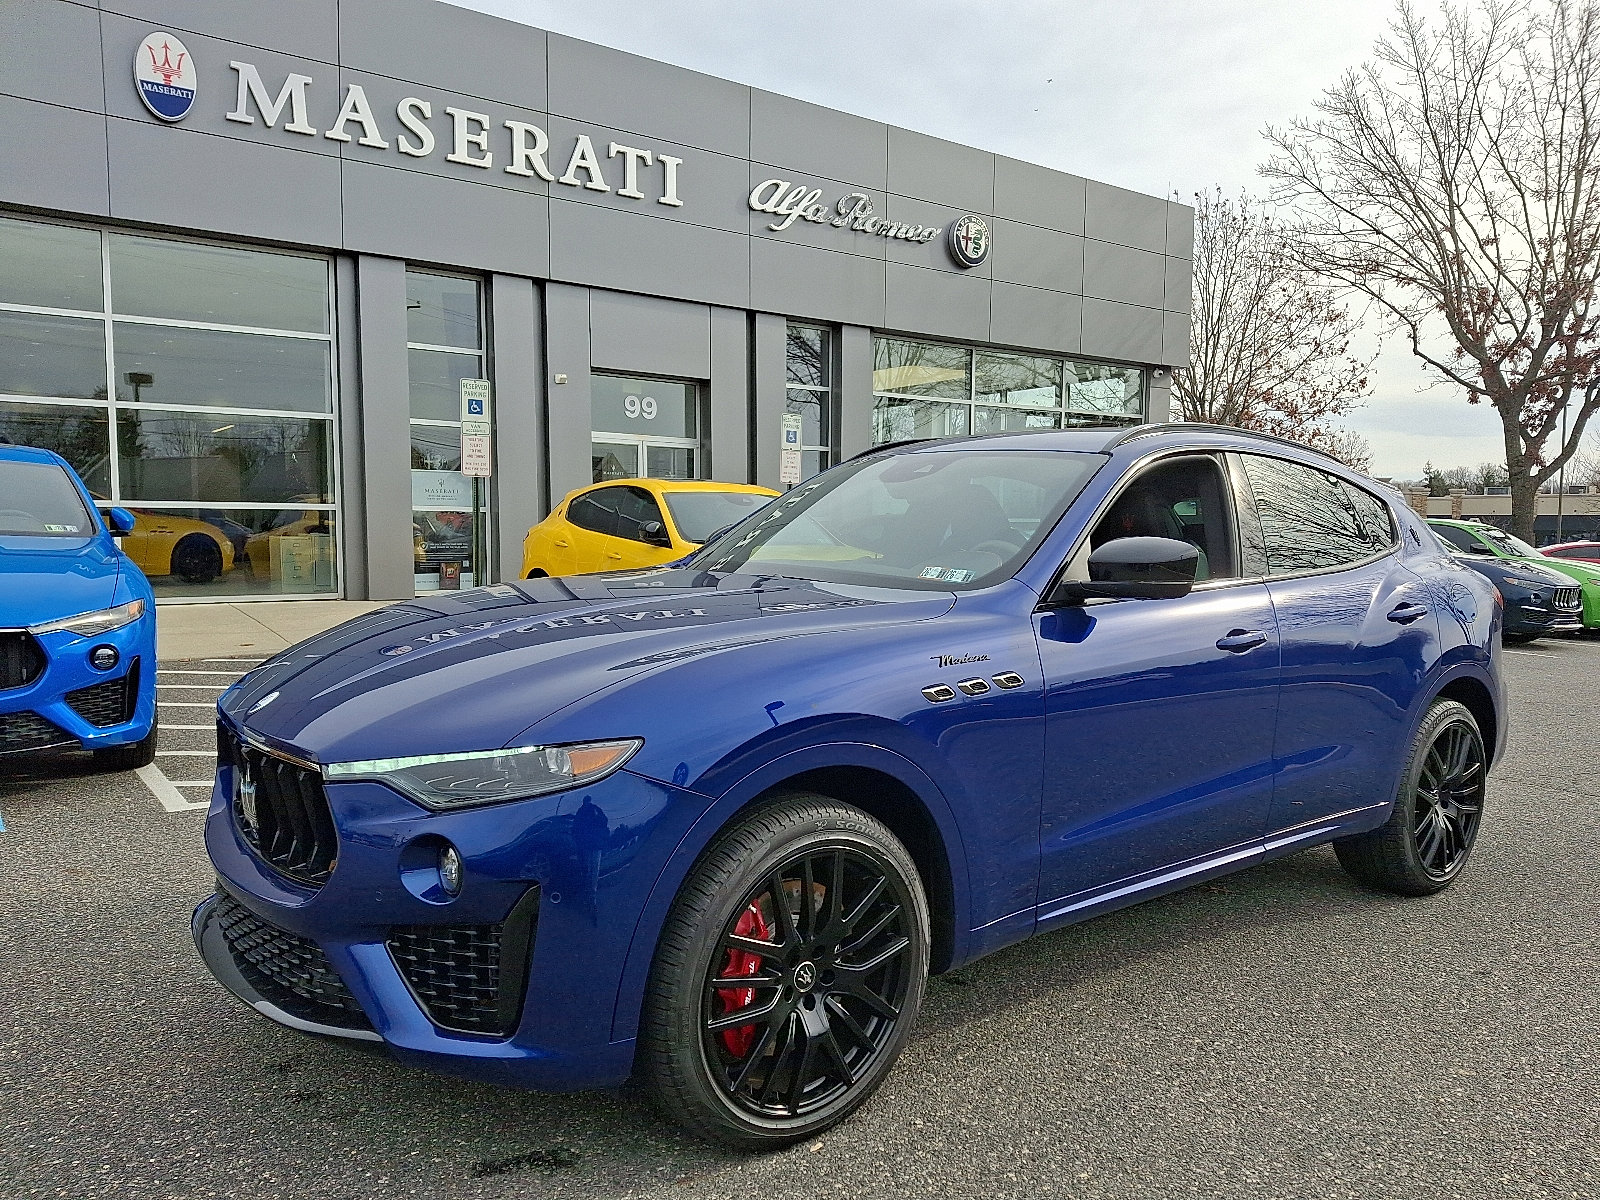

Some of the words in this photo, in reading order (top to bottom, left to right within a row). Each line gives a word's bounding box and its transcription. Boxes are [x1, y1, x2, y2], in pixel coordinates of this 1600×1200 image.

[142, 82, 192, 99] MASERATI
[225, 60, 684, 207] MASERATI
[749, 178, 832, 231] Alfa
[831, 192, 942, 243] Romeo
[462, 382, 488, 391] RESERVED
[463, 390, 487, 398] PARKING
[623, 395, 658, 420] 99
